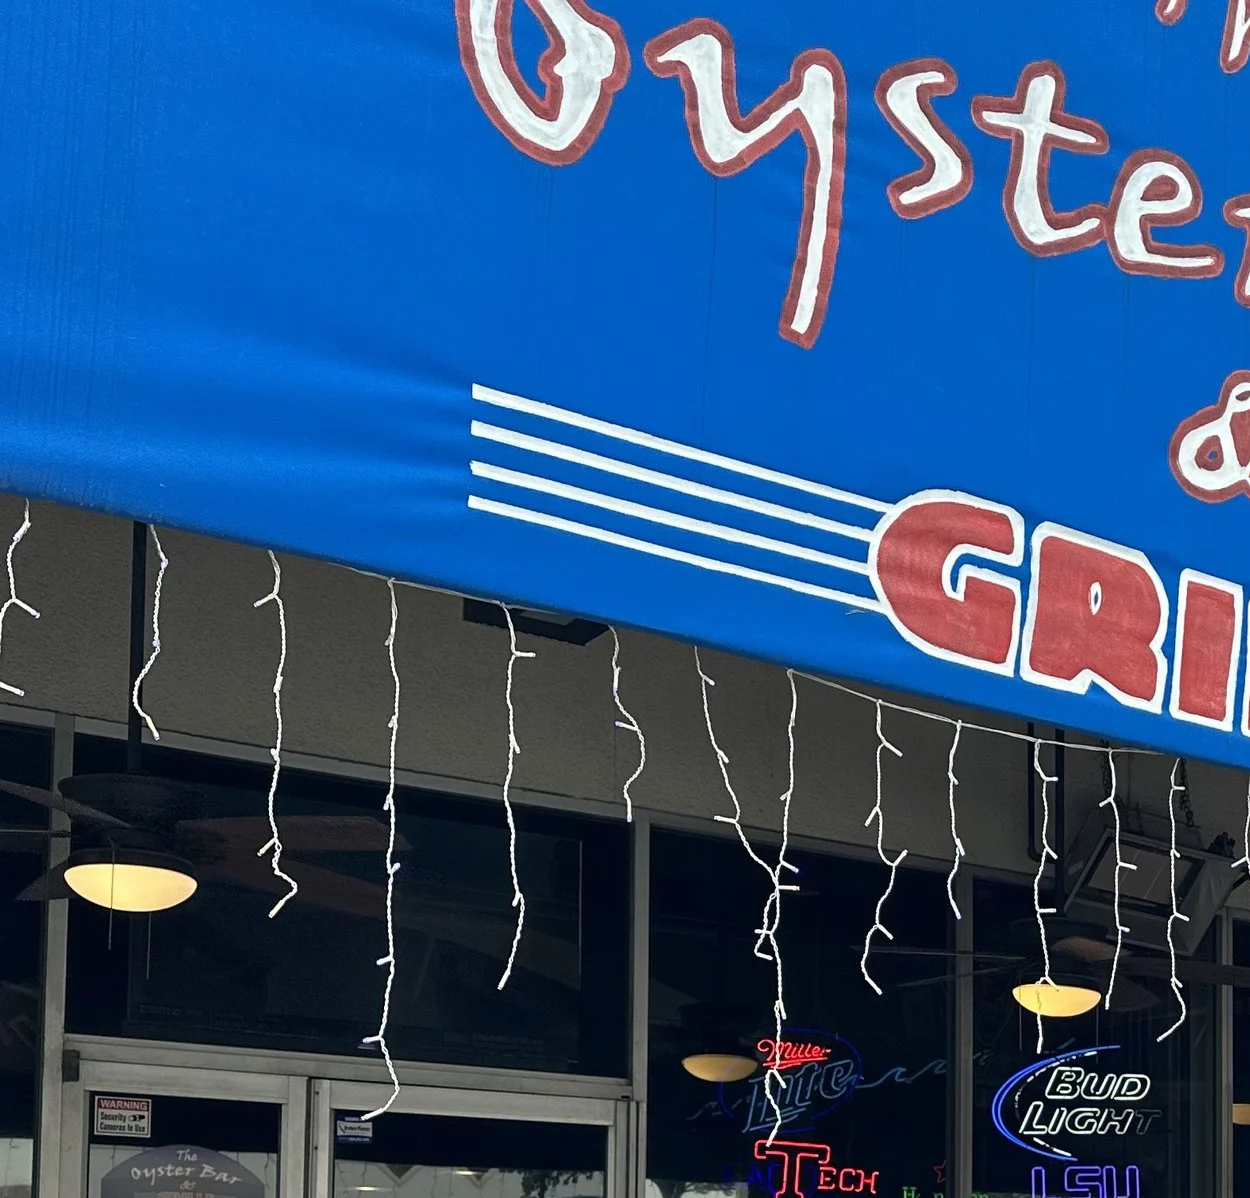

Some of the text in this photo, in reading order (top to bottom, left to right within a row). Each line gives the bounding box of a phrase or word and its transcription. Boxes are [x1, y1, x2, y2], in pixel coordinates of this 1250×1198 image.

[1045, 1067, 1151, 1101] BUD
[100, 1100, 148, 1111] WARNING
[100, 1112, 127, 1123] Security
[1019, 1101, 1163, 1135] LIGHT
[100, 1122, 126, 1132] Cameras
[176, 1149, 198, 1161] The
[131, 1164, 243, 1185] Oyster Bar
